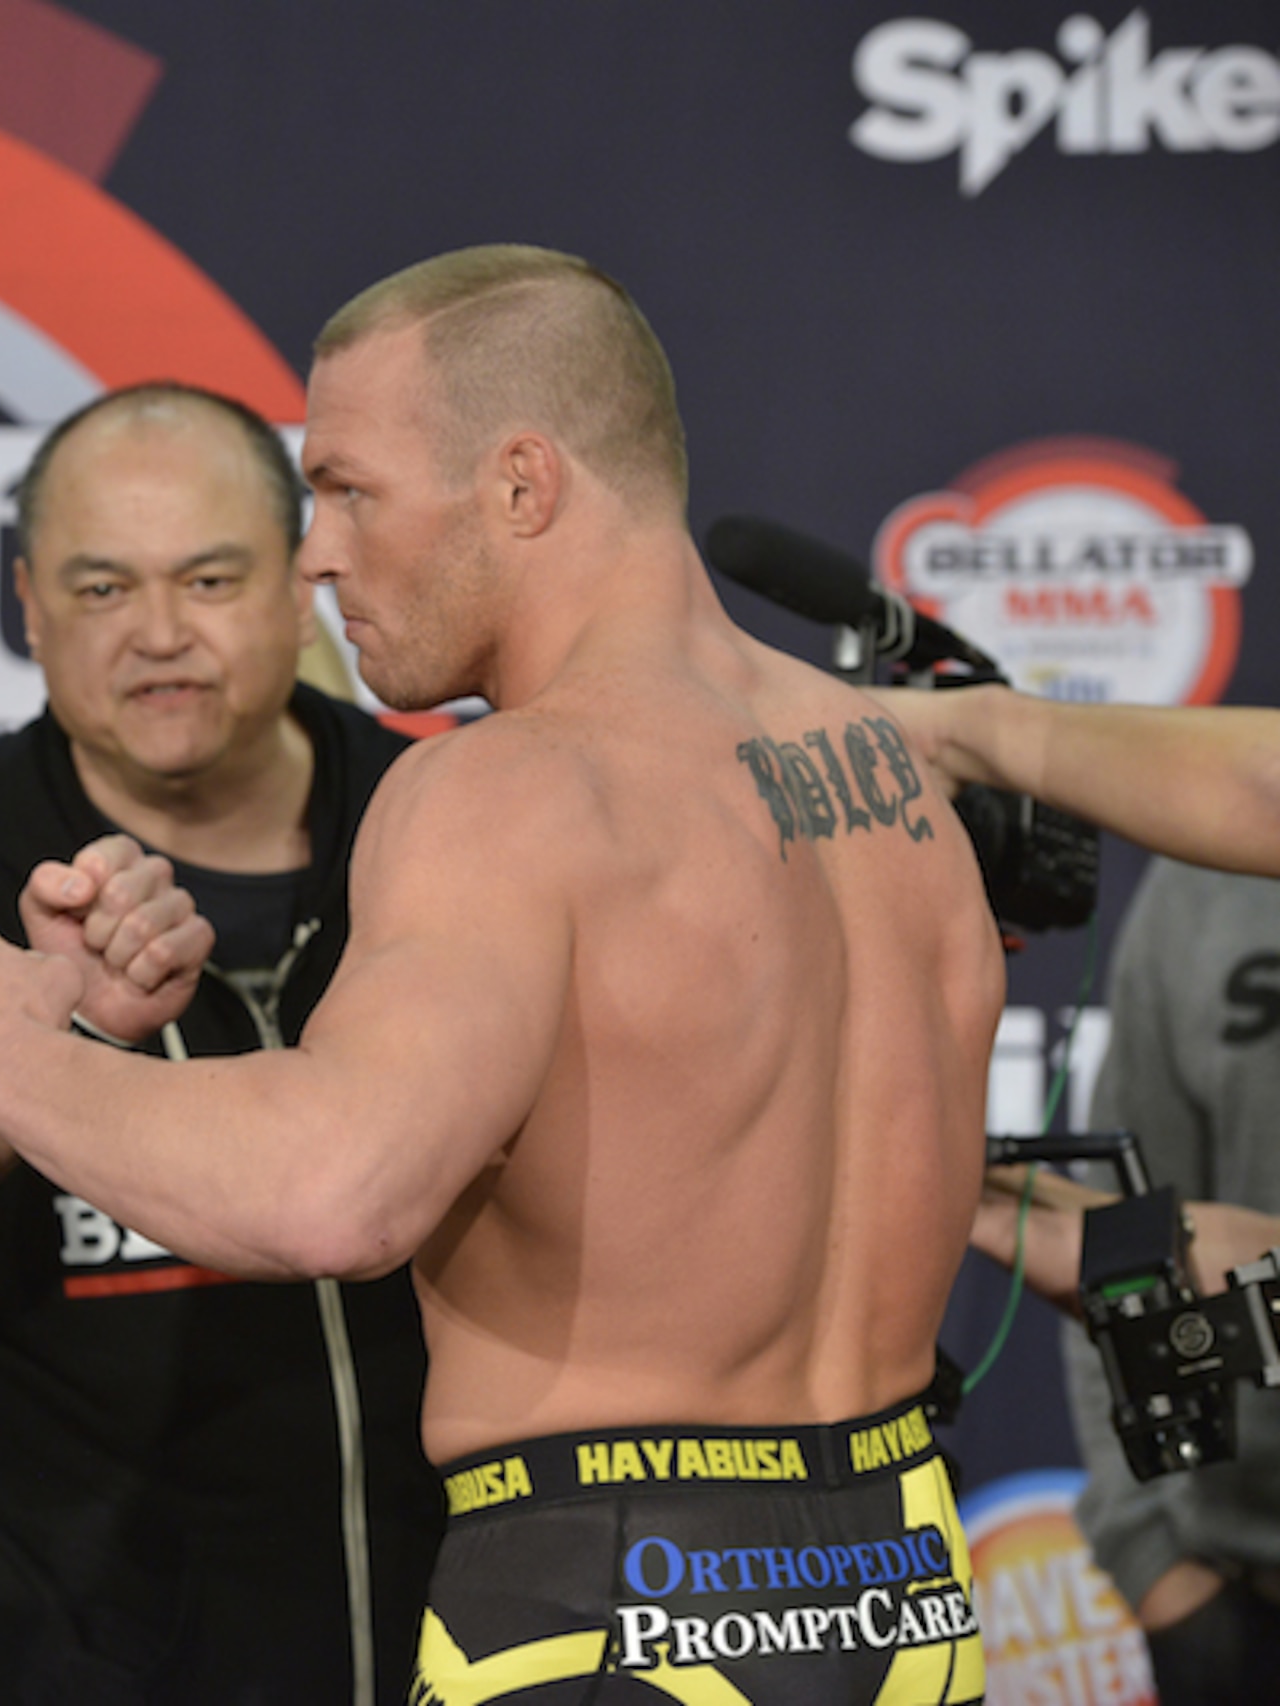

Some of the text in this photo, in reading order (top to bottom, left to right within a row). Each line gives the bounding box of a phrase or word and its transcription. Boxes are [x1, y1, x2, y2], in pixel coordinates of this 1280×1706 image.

[850, 10, 1280, 196] Spike
[927, 535, 1232, 577] BELLATOR
[1004, 584, 1157, 628] MMA
[576, 1439, 808, 1485] HAYABUSA
